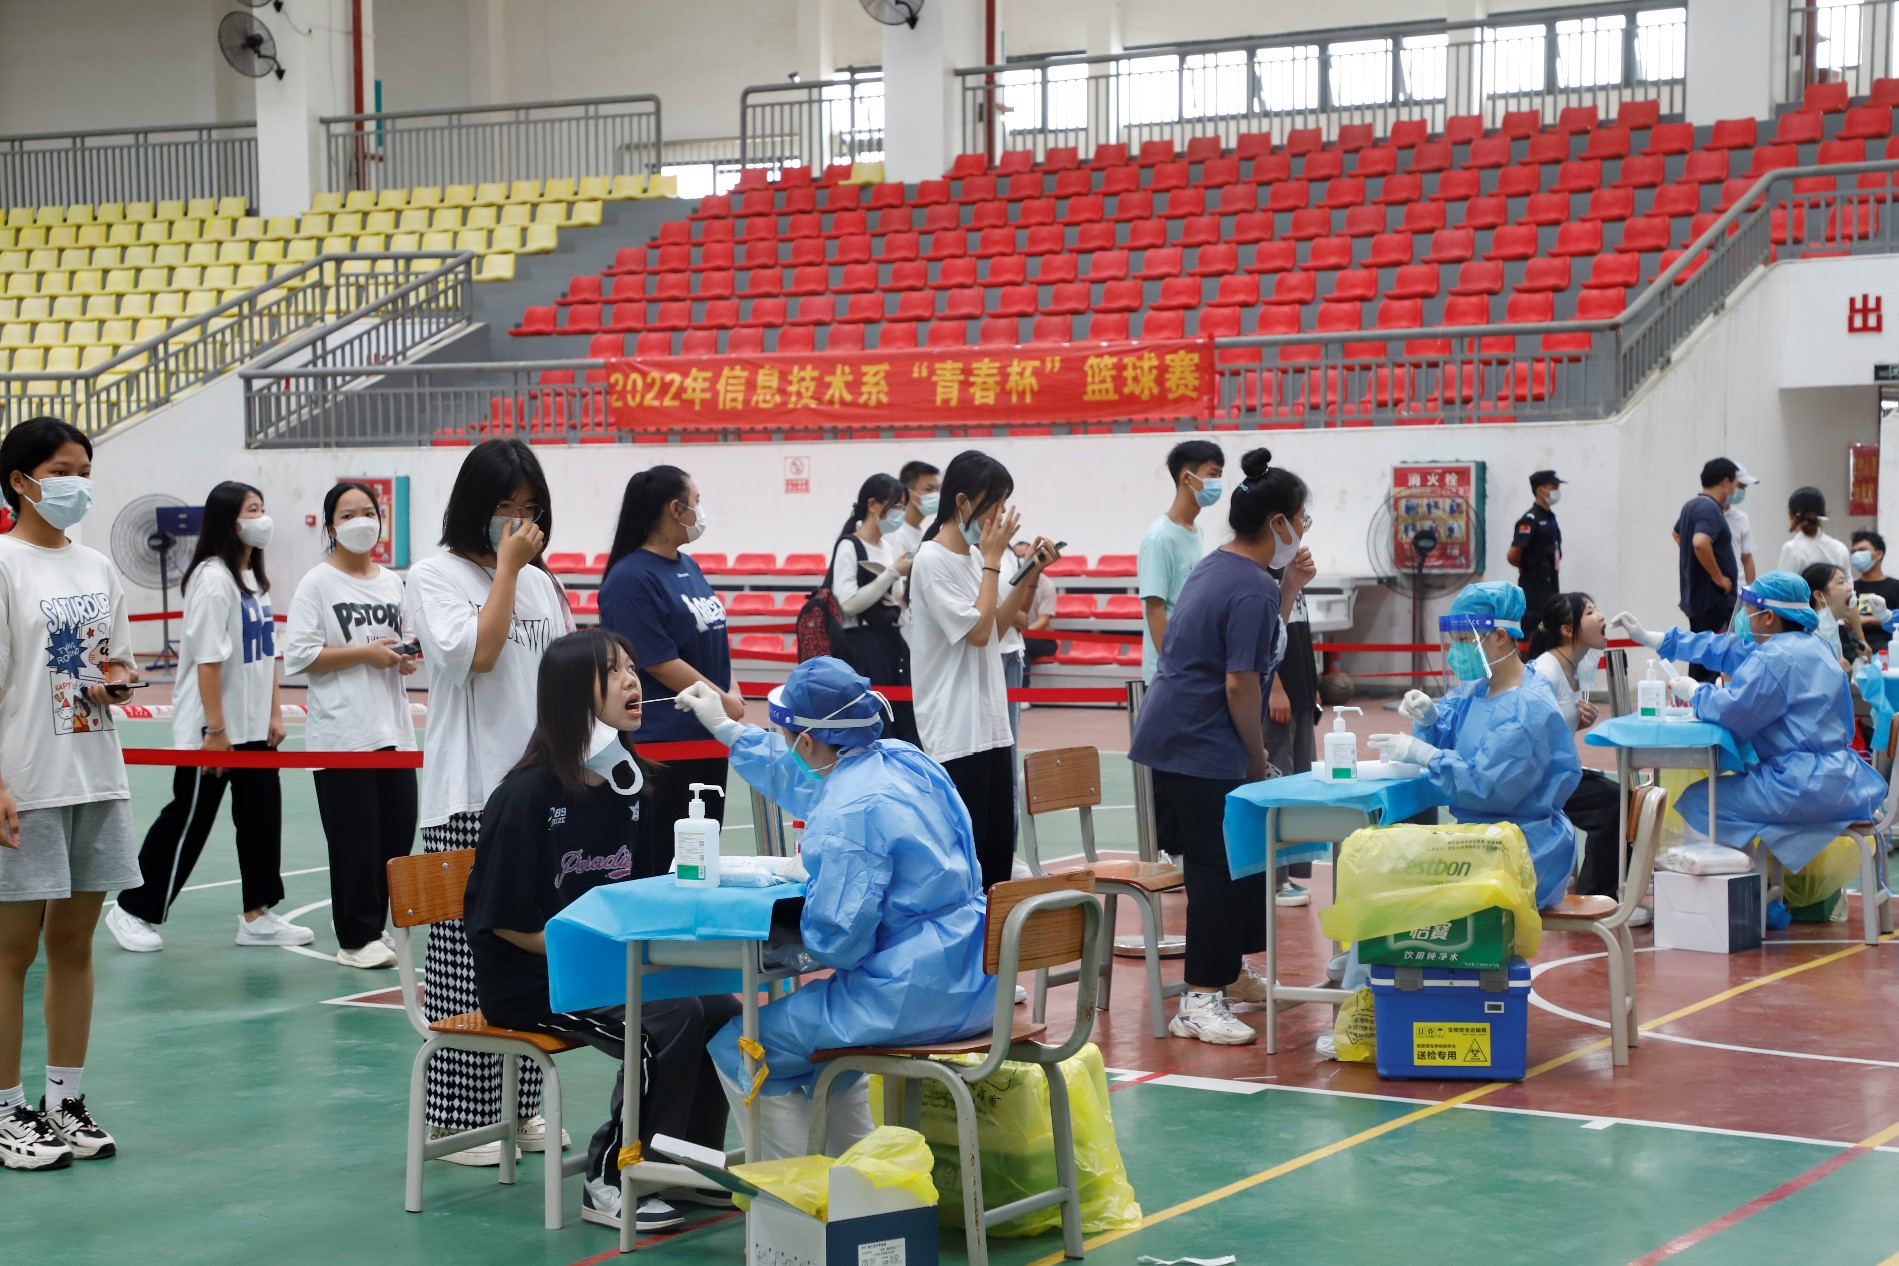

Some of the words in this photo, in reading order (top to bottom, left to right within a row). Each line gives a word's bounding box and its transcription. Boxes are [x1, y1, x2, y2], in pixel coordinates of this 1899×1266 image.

[1848, 294, 1882, 332] 出
[609, 361, 890, 411] 2022年信息技术系
[1083, 350, 1201, 403] 篮球赛
[1407, 472, 1458, 487] 消火栓
[1404, 950, 1459, 961] 饮用纯净水
[1416, 1050, 1457, 1060] 送检专用
